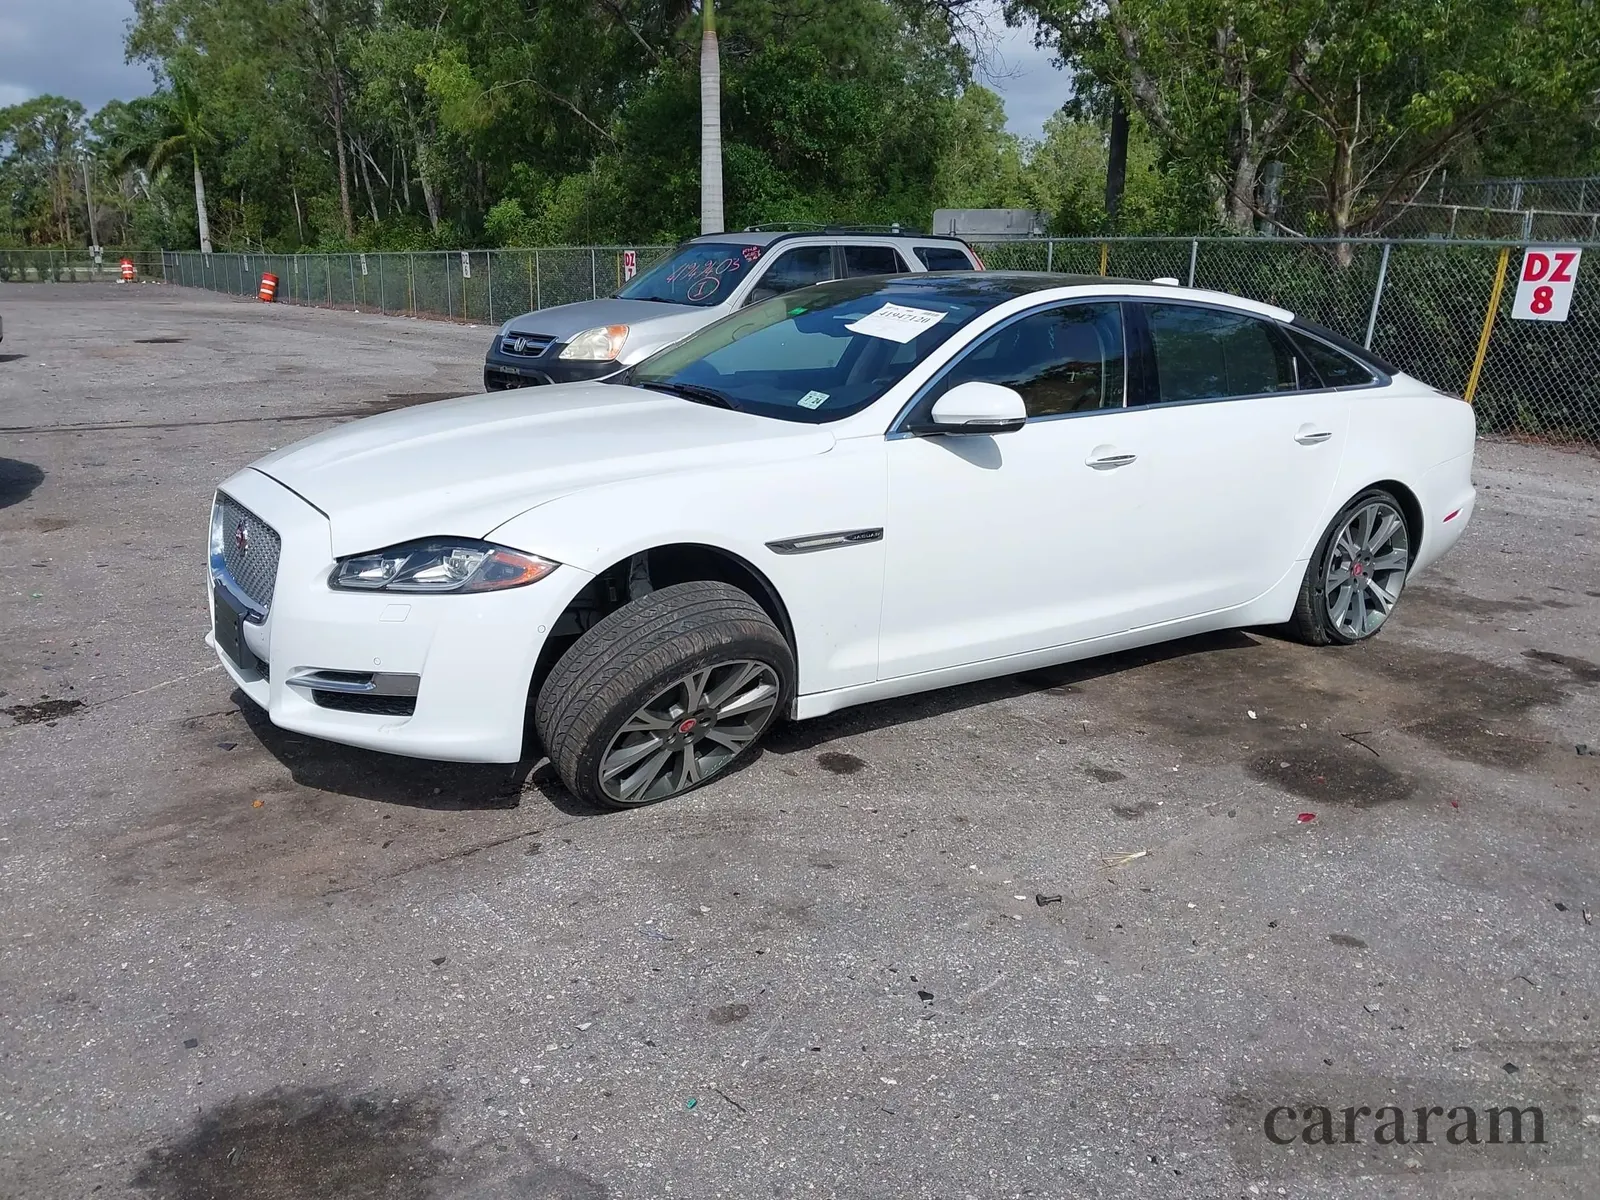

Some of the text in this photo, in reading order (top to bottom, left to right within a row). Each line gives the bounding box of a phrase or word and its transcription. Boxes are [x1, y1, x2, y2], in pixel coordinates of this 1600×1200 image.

[625, 253, 635, 266] DZ
[1523, 253, 1577, 282] DZ
[1530, 285, 1554, 315] 8
